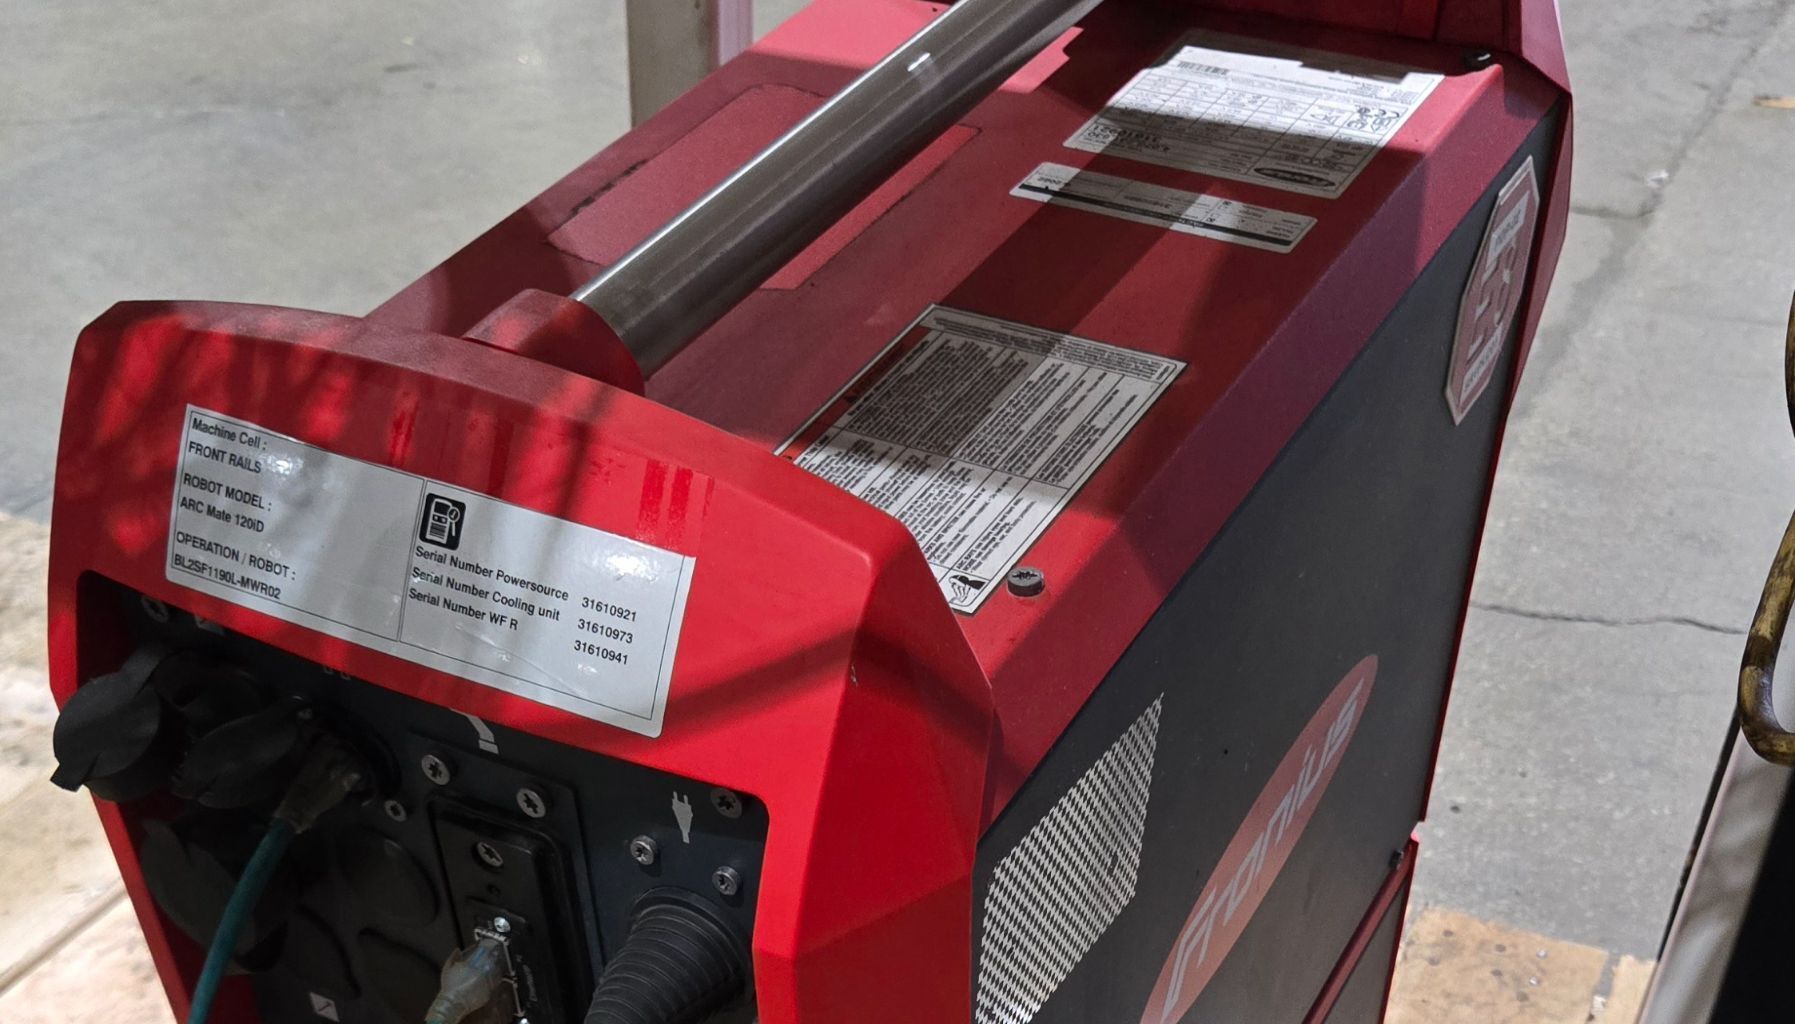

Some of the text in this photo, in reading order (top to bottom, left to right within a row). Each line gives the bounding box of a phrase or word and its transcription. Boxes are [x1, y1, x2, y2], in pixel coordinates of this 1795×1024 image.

[191, 418, 236, 442] Machine
[240, 431, 261, 449] Cell
[188, 441, 262, 474] FRONT RAILS
[180, 496, 265, 533] ARC Mate 120iD
[183, 472, 223, 495] ROBOT
[225, 486, 264, 510] MODEL
[174, 553, 281, 600] BL2SF1190L-MWR02
[176, 531, 240, 562] OPERATION
[248, 554, 290, 578] ROBOT
[412, 566, 634, 644] Serial Number Cooling unit 31610973
[415, 546, 637, 622] Serial Number Powersource 31610921
[408, 588, 628, 665] Serial Number WF R 31610941
